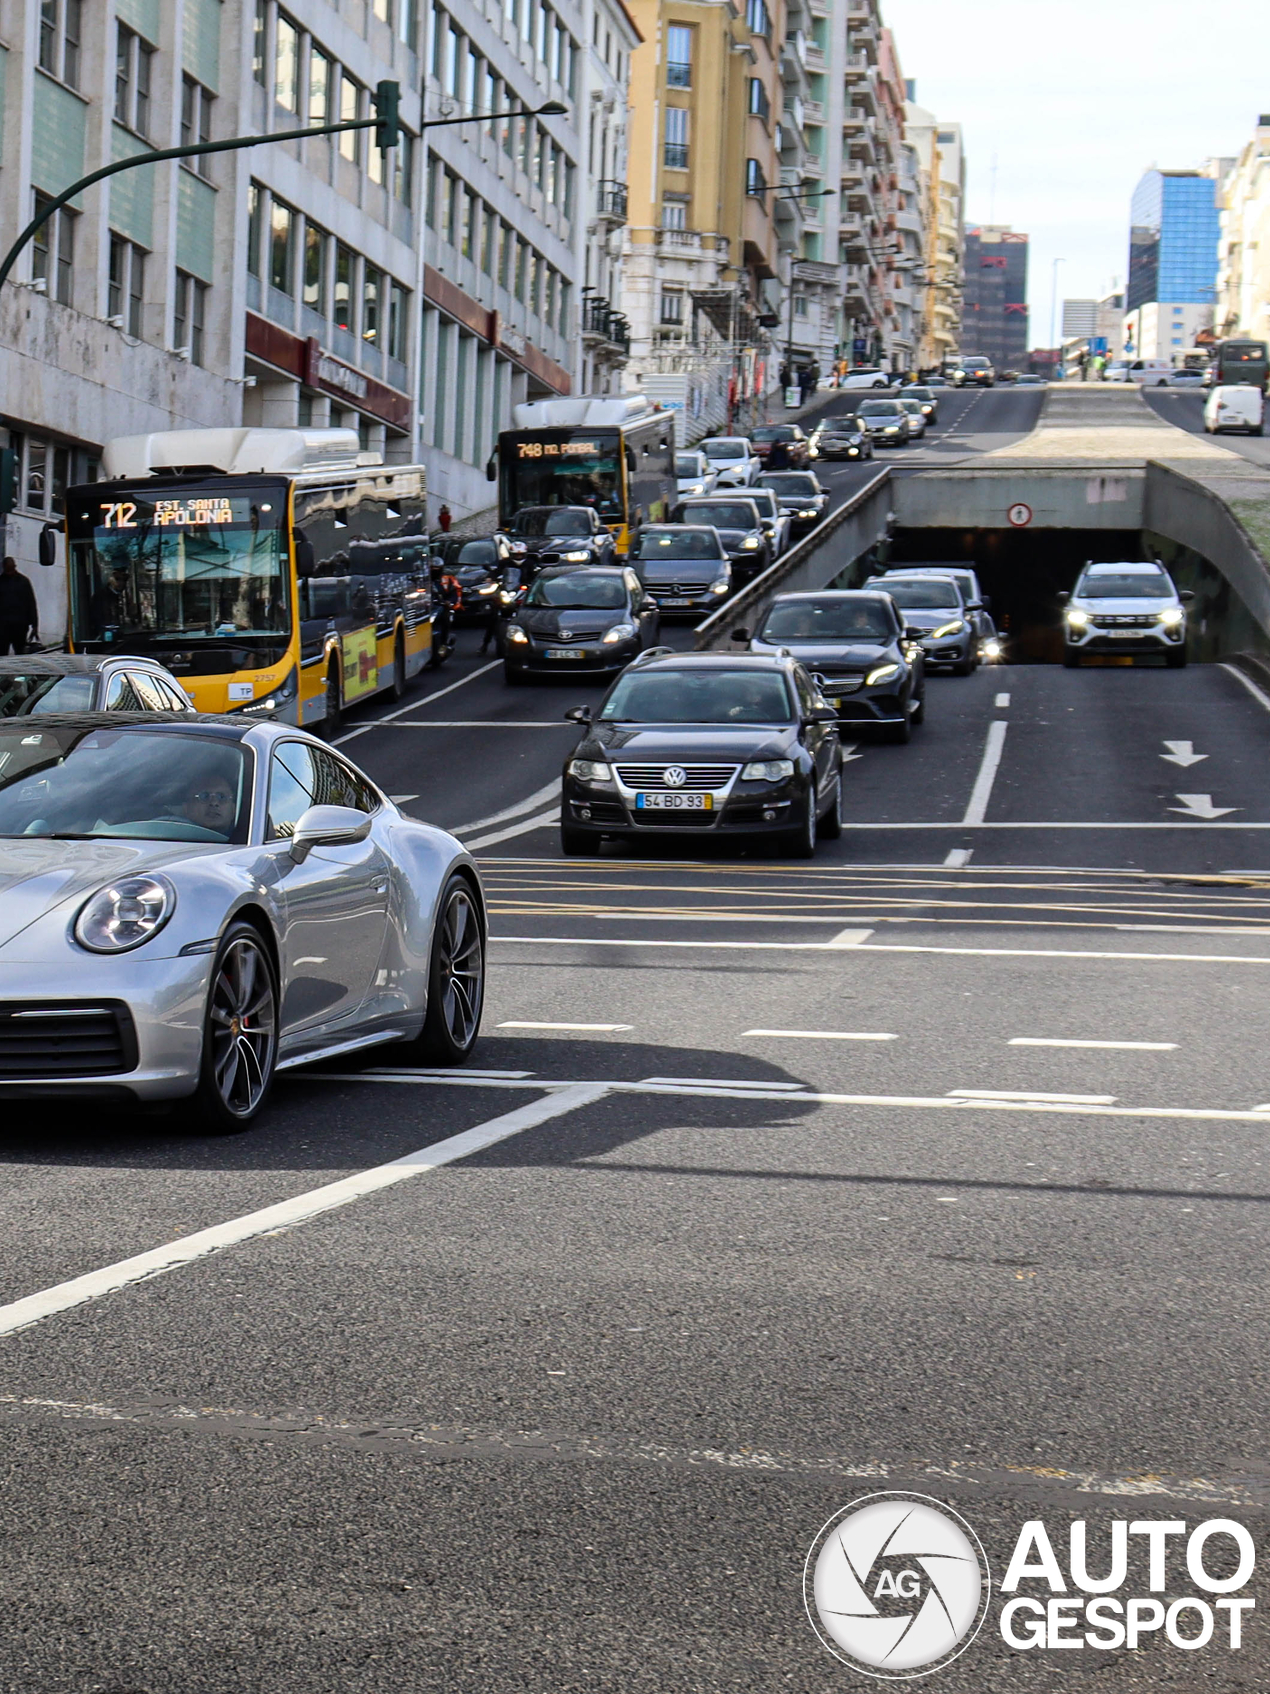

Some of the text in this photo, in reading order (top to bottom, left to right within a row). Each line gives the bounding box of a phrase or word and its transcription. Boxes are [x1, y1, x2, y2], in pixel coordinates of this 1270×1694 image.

[516, 442, 543, 458] 748
[560, 442, 599, 454] POMBAL
[100, 498, 230, 529] 712 EST. SANTA
[153, 508, 233, 526] APOLONIA
[239, 687, 253, 696] TP
